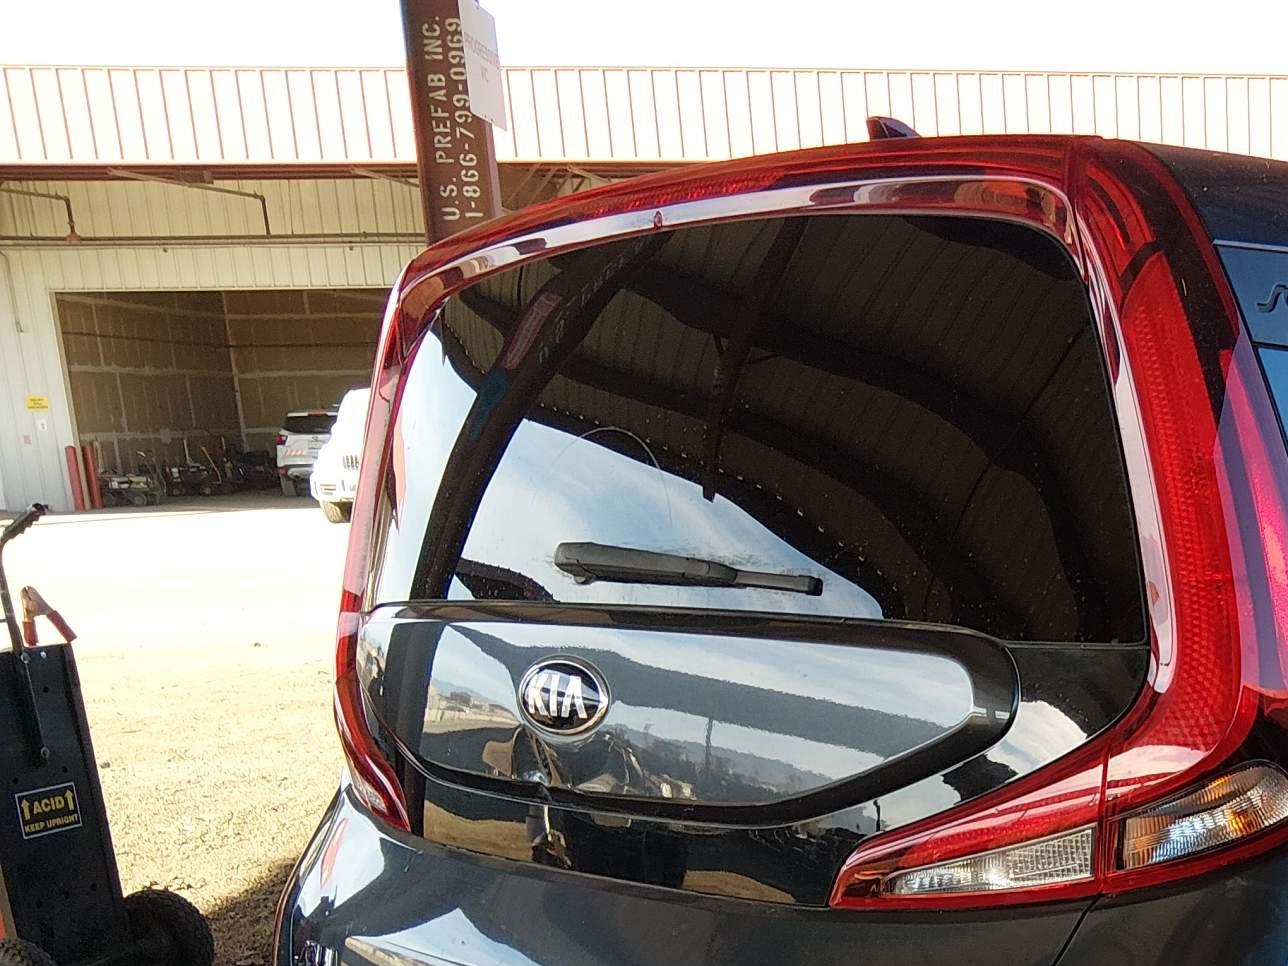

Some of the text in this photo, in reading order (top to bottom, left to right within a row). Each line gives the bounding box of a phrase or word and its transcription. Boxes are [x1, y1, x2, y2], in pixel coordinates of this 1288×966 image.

[422, 16, 461, 221] U.S. PREFAB INC.
[445, 17, 483, 218] 1-866-799-0969
[525, 672, 588, 719] KIA
[24, 814, 79, 833] KEEP UPRIGHT
[33, 796, 65, 814] ACID
